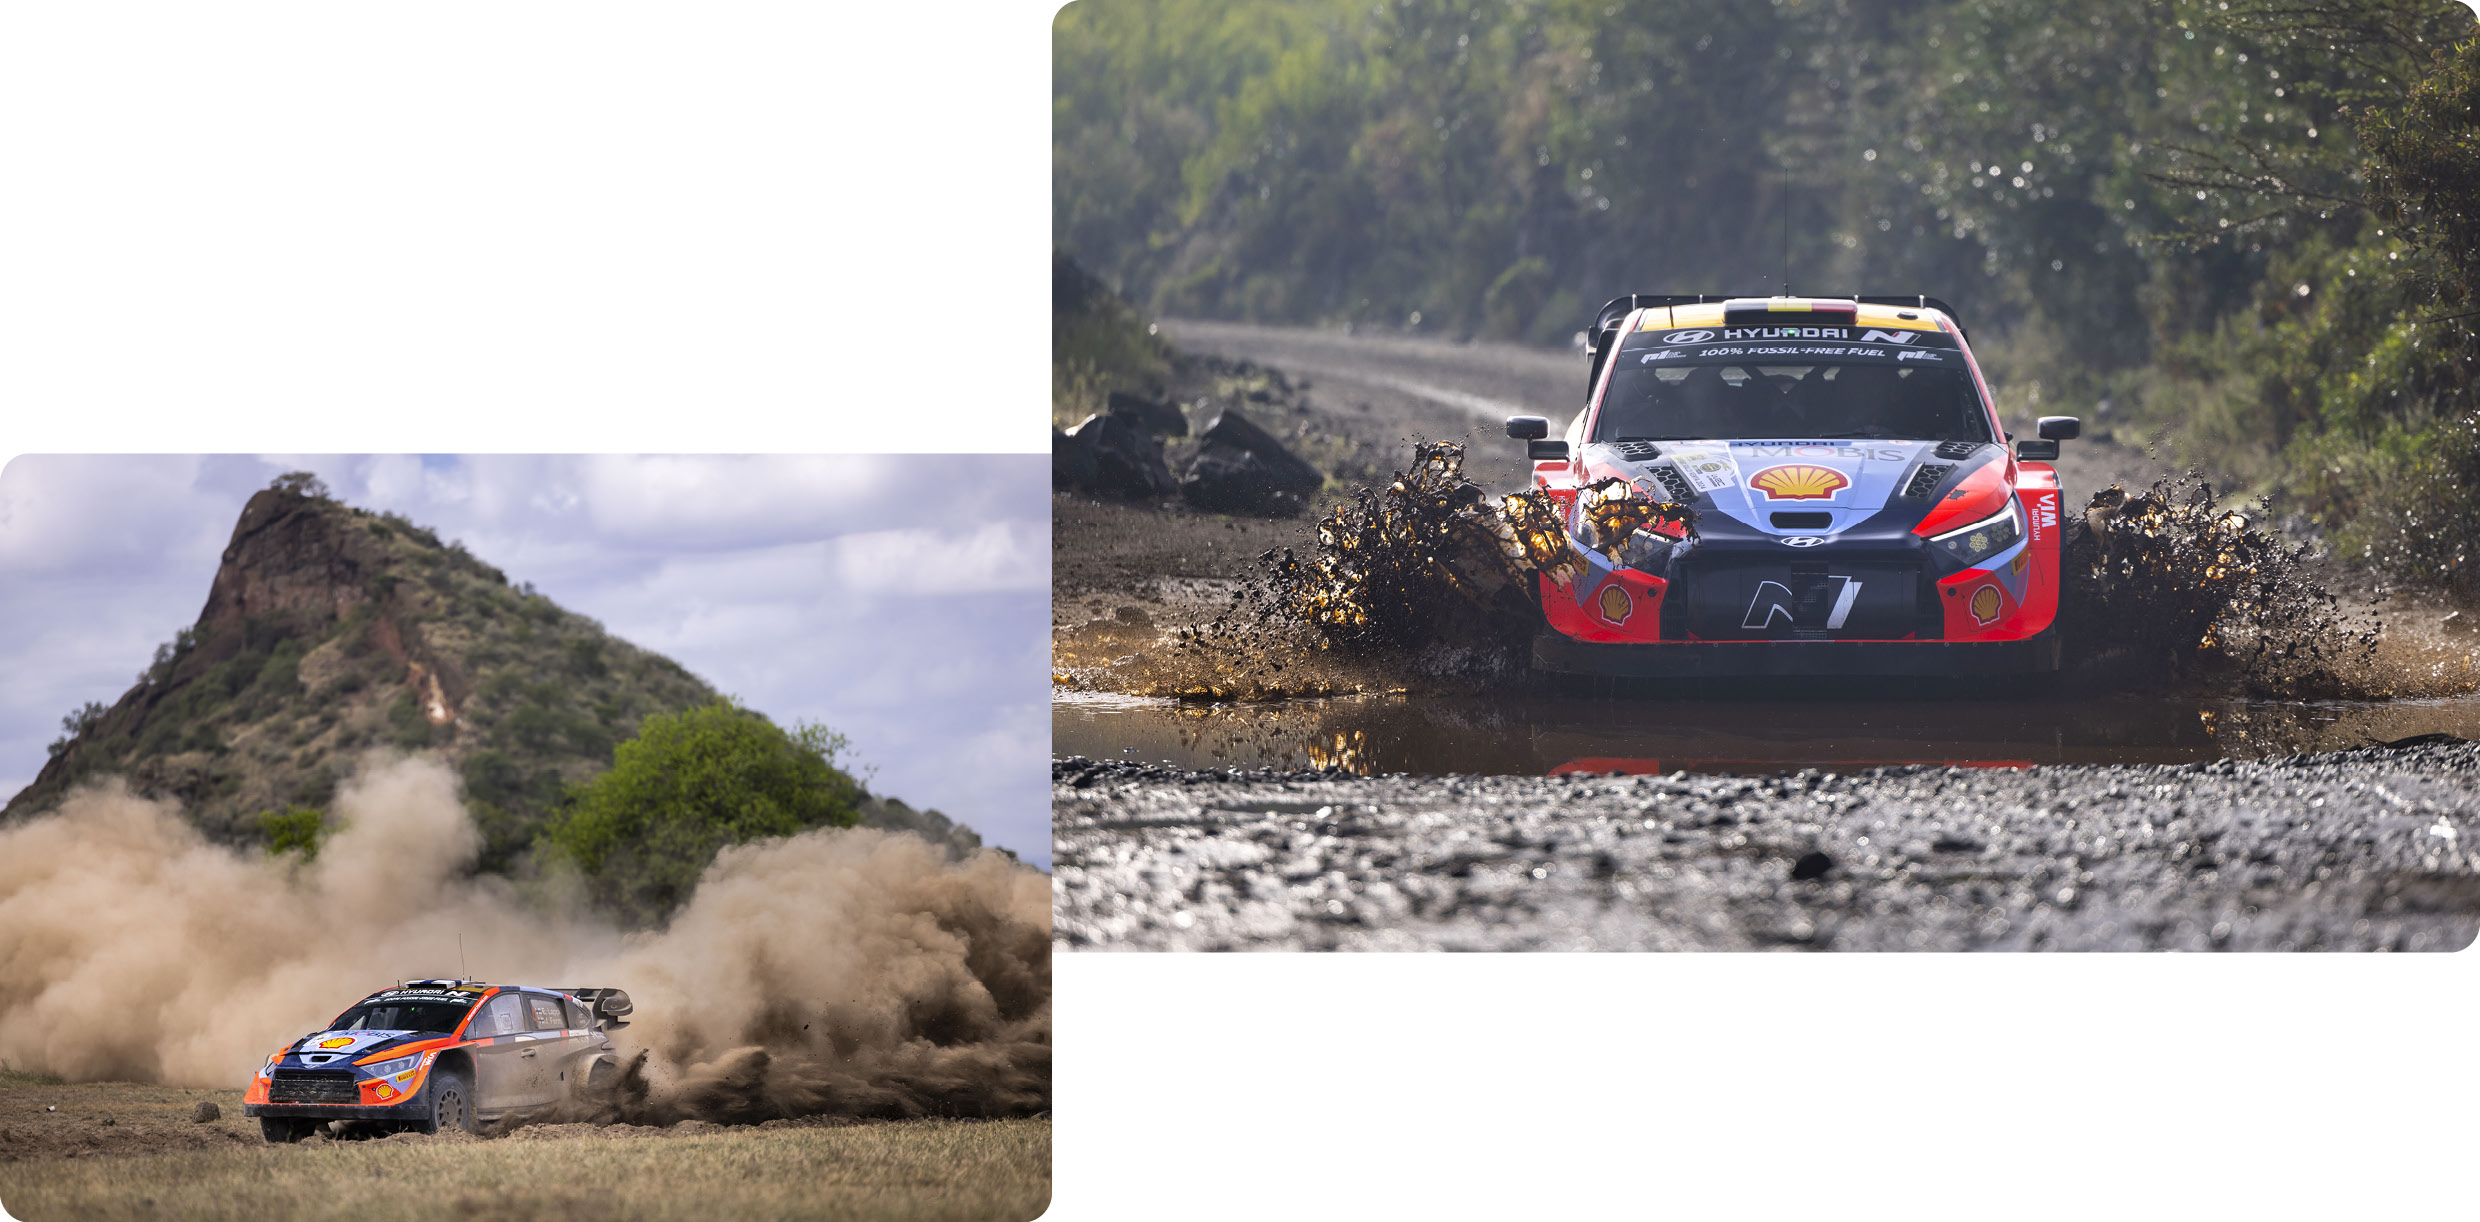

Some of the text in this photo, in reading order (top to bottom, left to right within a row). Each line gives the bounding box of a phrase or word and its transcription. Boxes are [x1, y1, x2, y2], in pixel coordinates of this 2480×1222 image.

[1724, 327, 1848, 339] HYUNDAI
[1698, 347, 1744, 357] 100%
[1746, 346, 1846, 355] FOSSIL-FREE
[1847, 347, 1886, 357] FUEL
[1751, 446, 1905, 462] MOBIS
[2037, 493, 2057, 528] WIA
[2031, 508, 2041, 541] HYUNDAI
[547, 1007, 561, 1017] Lapp
